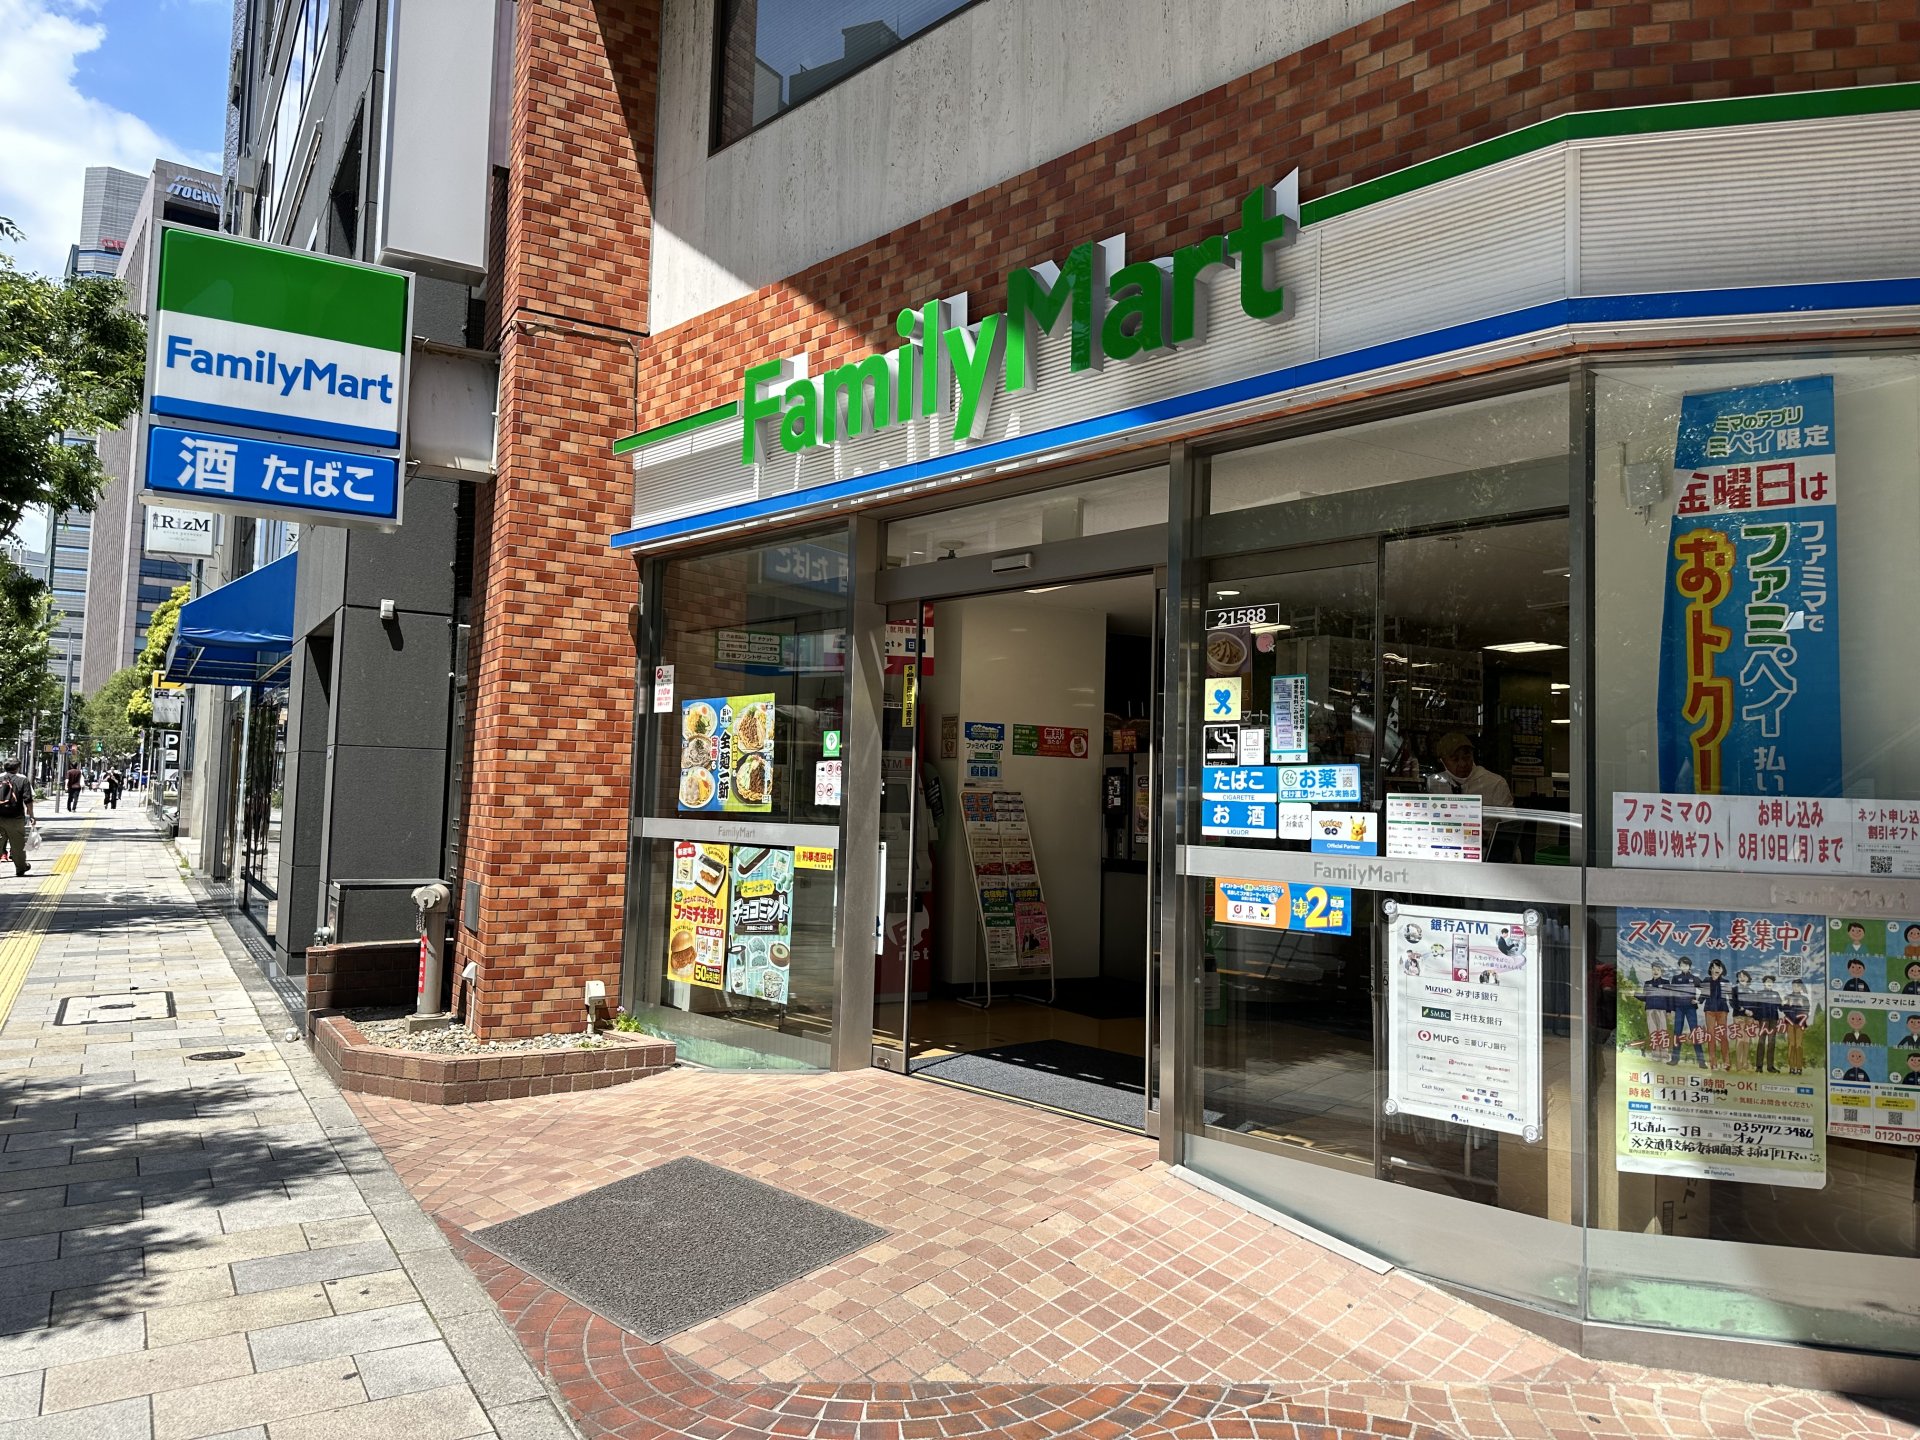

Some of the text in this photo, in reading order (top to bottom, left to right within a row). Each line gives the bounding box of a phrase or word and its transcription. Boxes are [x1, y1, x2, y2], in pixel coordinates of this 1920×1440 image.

[166, 183, 221, 206] ITOCHU
[741, 184, 1290, 465] FamilyMart
[166, 335, 392, 404] FamilyMart
[177, 436, 375, 502] 酒 たばこ
[1677, 462, 1829, 515] 金曜日は
[161, 514, 211, 532] RizM
[1801, 520, 1826, 632] ファミマで
[1217, 608, 1266, 626] 21588
[1739, 521, 1797, 738] ファミペイ
[166, 734, 179, 749] P
[717, 730, 732, 801] 全麺一新
[1213, 770, 1265, 791] たばこ
[1299, 769, 1337, 789] お薬
[1213, 804, 1266, 827] お酒
[1623, 798, 1713, 825] ファミマの
[1757, 799, 1824, 829] お申し込み
[717, 826, 756, 840] FamilyMart
[1285, 821, 1304, 829] 対象店
[1324, 827, 1338, 836] GO
[1867, 825, 1919, 841] 割引ギフト
[1616, 828, 1725, 860] 夏の贈り物ギフト
[1738, 833, 1844, 864] 8月19日(月)まで
[1313, 862, 1410, 884] FamilyMart
[673, 903, 724, 926] ファミチキ祭り
[732, 895, 790, 926] チョコミント
[1430, 919, 1489, 935] 銀行ATM
[1627, 917, 1815, 953] スタッフさん募集中!
[1425, 985, 1498, 1002] MIZUHO みずほ銀行
[1870, 997, 1916, 1006] ファミマには
[1430, 1009, 1503, 1027] SMBC 三井住友銀行
[1433, 1034, 1507, 1051] MUFG 三菱UFJ銀行
[1628, 1014, 1810, 1050] 一緒に働きませんか?
[1628, 1087, 1651, 1098] 時給
[1830, 1087, 1871, 1095] パート・アルバイト
[1630, 1121, 1701, 1138] 北青山一丁目
[1733, 1132, 1763, 1145] オカノ
[1710, 1169, 1736, 1177] FamilyMart
